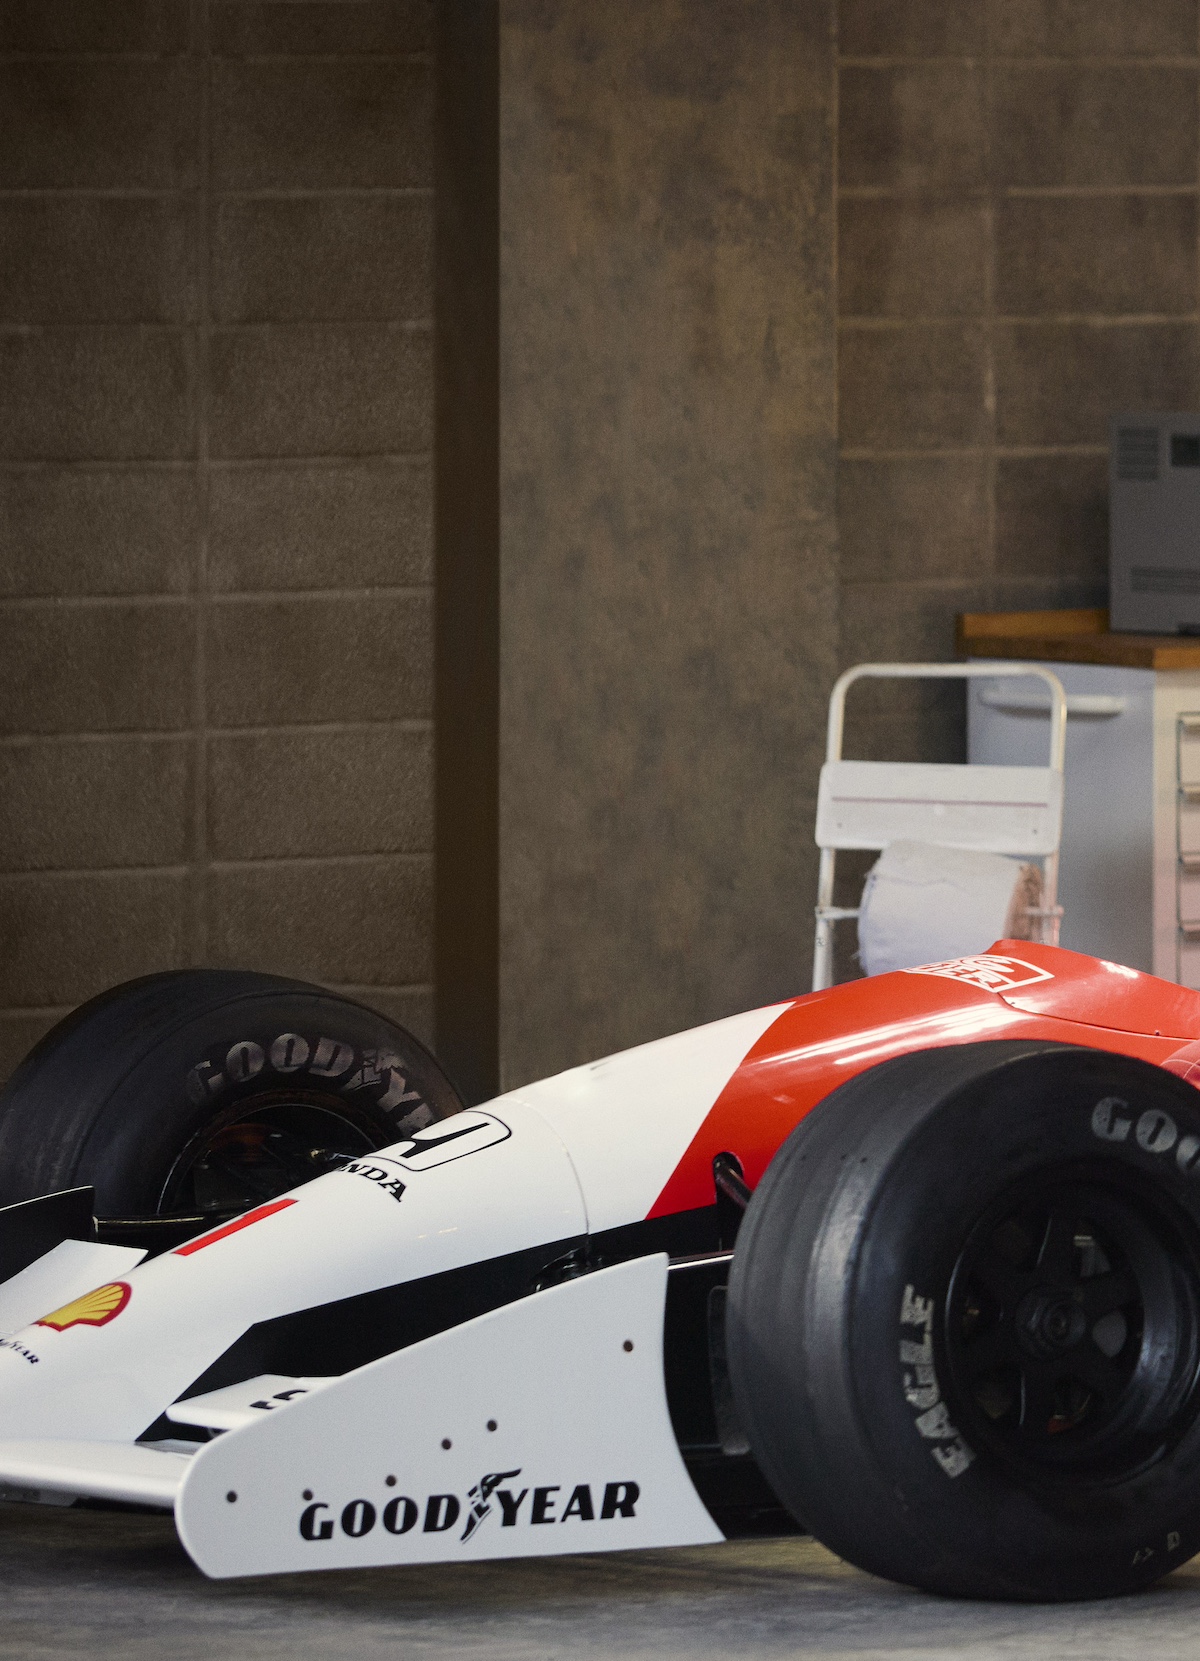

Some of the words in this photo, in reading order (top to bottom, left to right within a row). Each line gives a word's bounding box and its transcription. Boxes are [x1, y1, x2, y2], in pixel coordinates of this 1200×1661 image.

[337, 1163, 407, 1203] NDA
[900, 1284, 977, 1478] EAGLE
[300, 1470, 641, 1543] GOODYEAR
